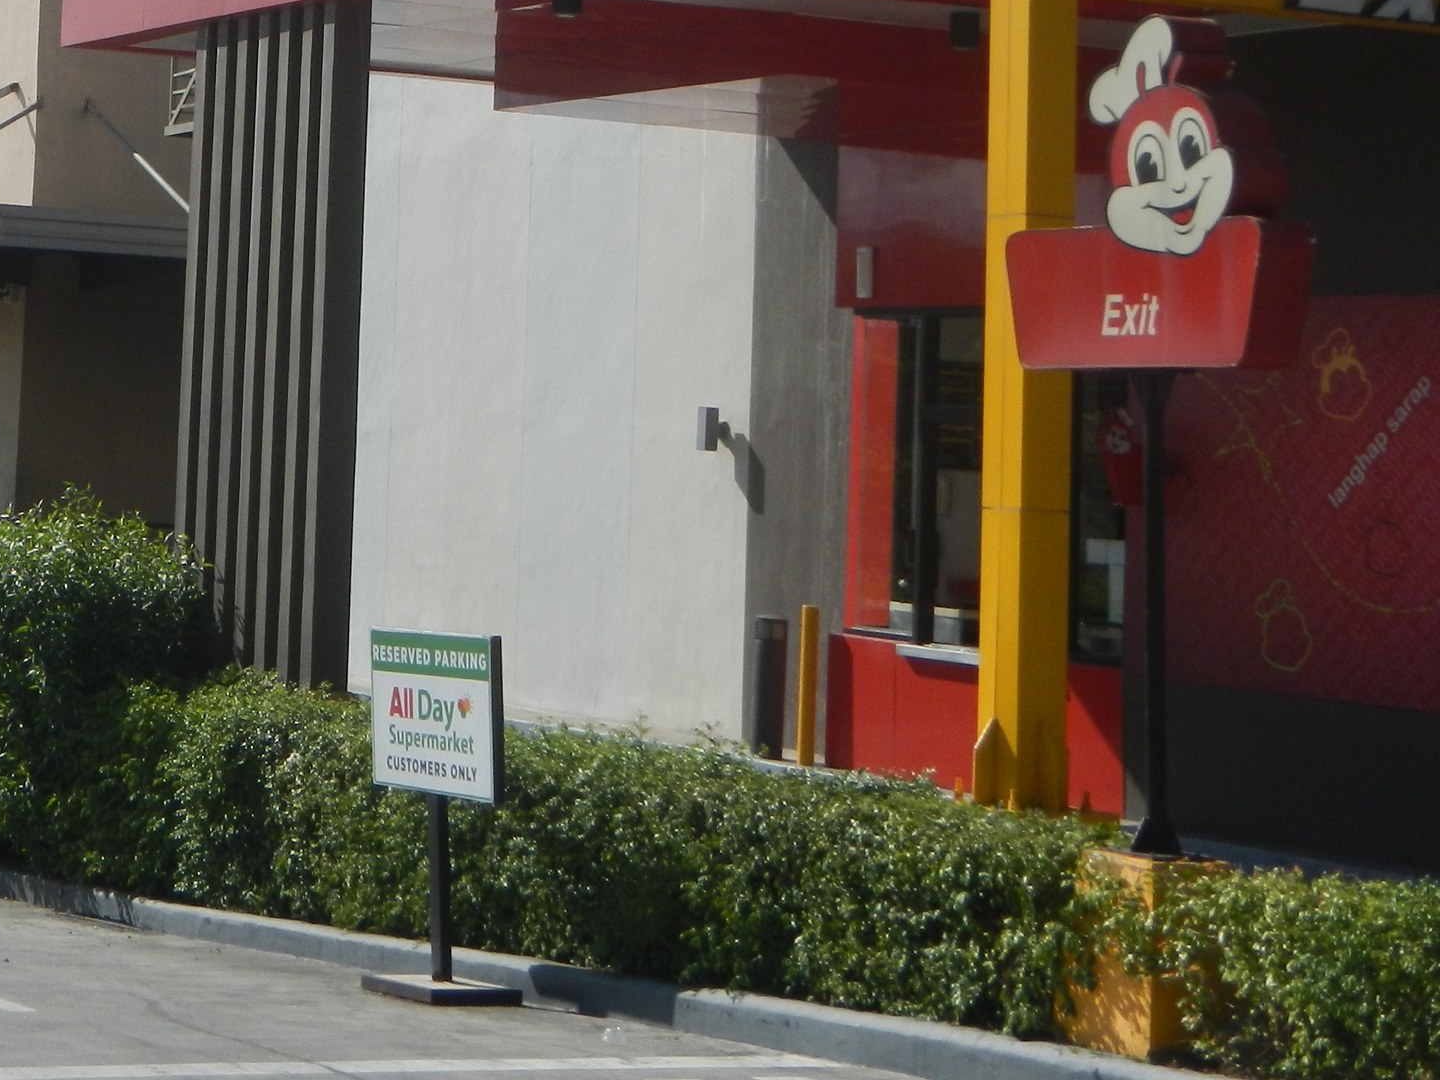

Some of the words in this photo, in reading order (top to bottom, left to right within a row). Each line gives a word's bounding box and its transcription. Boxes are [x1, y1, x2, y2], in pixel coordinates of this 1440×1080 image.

[1100, 293, 1159, 337] Exit
[1326, 432, 1388, 508] langhap
[1387, 376, 1432, 432] sarap
[372, 644, 431, 665] RESERVED
[434, 649, 487, 671] PARKING
[389, 724, 474, 755] Supermarket
[386, 755, 447, 778] CUSTOMERS
[450, 764, 478, 782] ONLY
